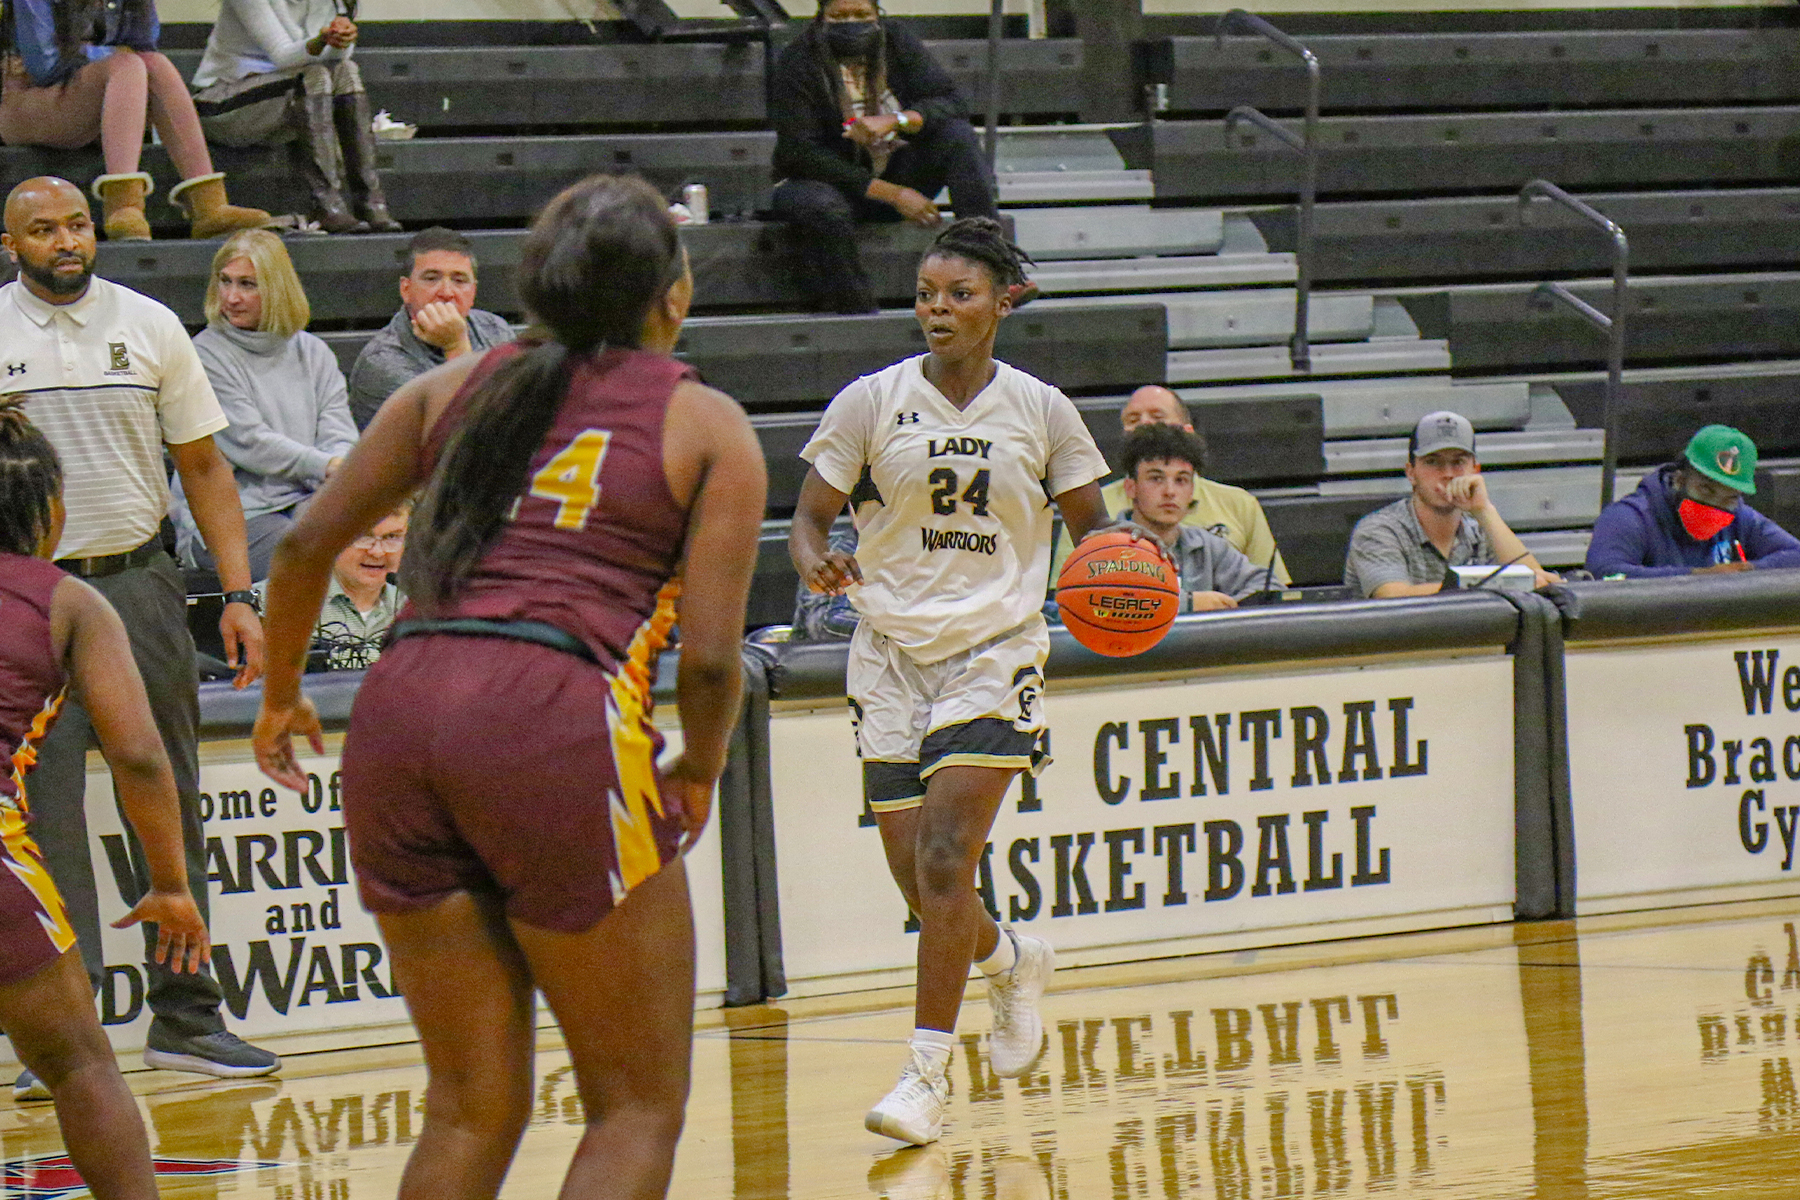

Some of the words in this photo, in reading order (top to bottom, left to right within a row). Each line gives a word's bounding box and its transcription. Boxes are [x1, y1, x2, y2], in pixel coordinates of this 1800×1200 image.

[928, 437, 993, 460] LADY
[508, 427, 612, 533] 4
[928, 467, 990, 517] 24
[921, 526, 997, 556] WARRIORS
[1087, 559, 1165, 583] SPALDING
[1089, 593, 1162, 610] LEGACY
[1733, 649, 1800, 716] We
[1094, 696, 1428, 805] CENTRAL
[200, 785, 277, 823] ome
[1738, 789, 1800, 871] Gy
[99, 826, 349, 910] ARRI
[904, 805, 1391, 934] SKETBALL
[265, 888, 342, 935] and
[211, 936, 404, 1021] WAR
